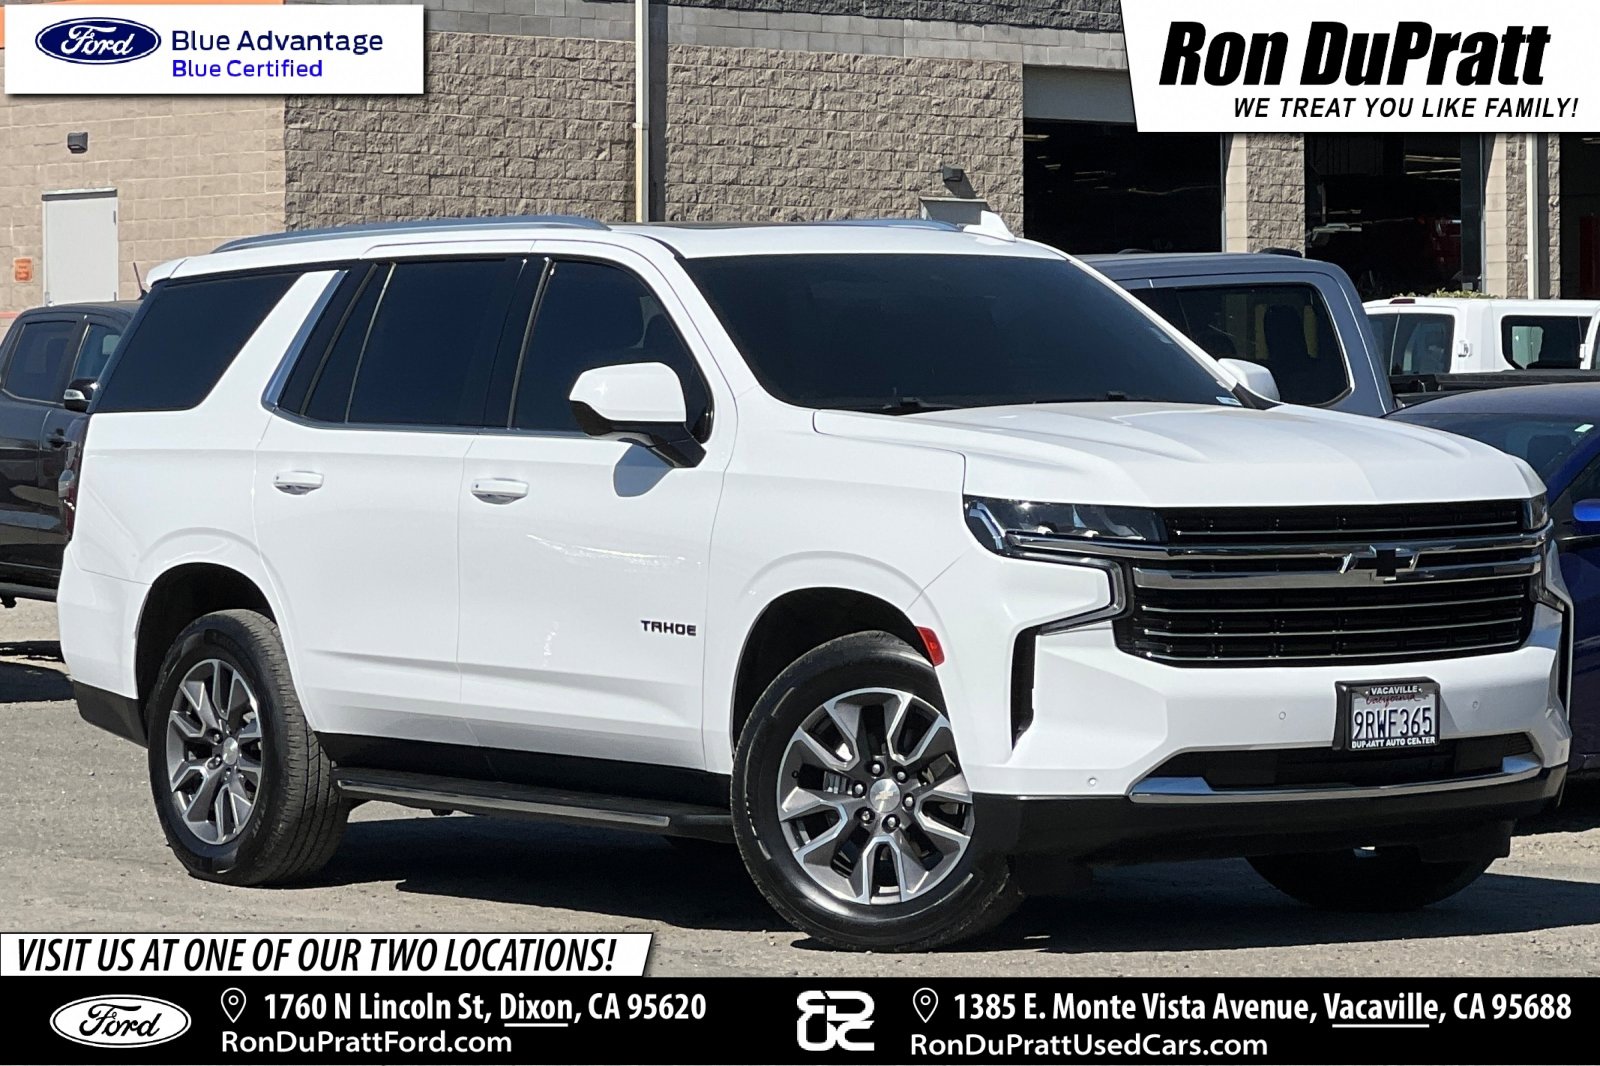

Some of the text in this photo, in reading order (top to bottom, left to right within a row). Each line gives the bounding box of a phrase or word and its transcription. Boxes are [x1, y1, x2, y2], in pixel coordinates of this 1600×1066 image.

[640, 619, 697, 637] TAHOE
[1371, 685, 1418, 696] VACAVILLE
[1353, 705, 1433, 740] 9RWF365
[1385, 738, 1406, 747] AUTO
[1406, 736, 1436, 746] CENTER
